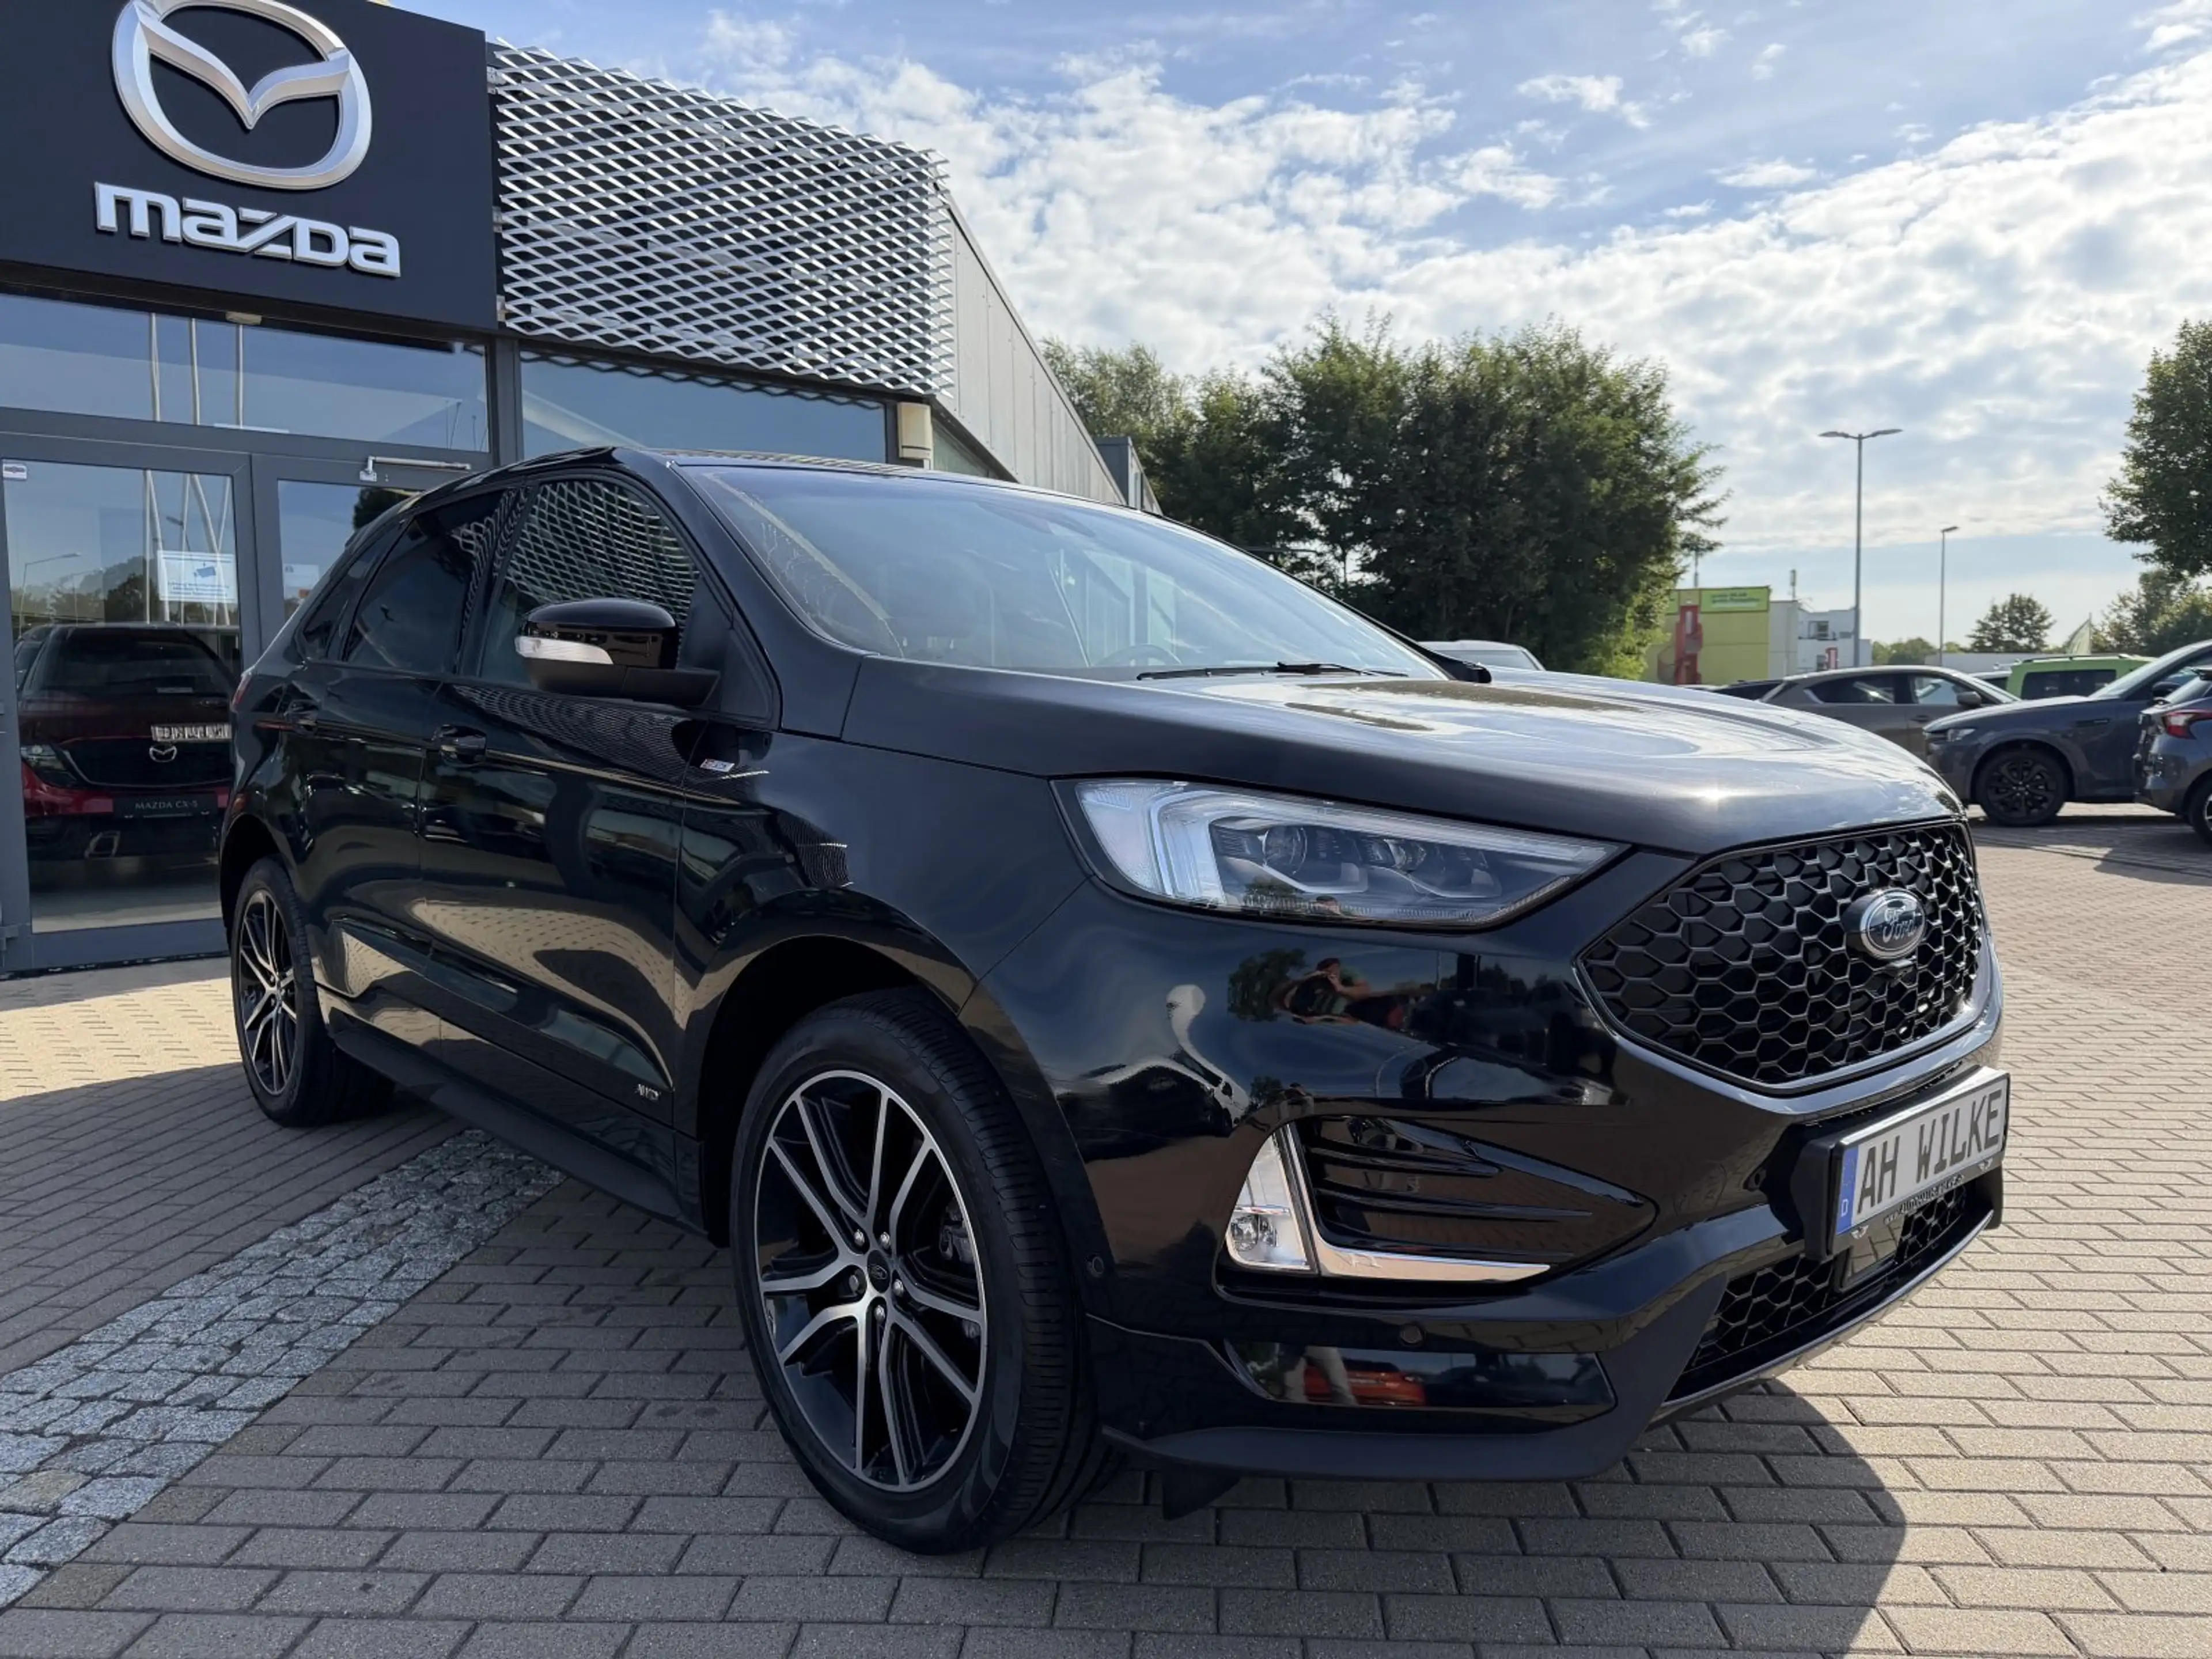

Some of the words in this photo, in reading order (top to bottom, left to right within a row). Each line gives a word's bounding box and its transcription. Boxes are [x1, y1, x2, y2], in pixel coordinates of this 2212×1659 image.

[135, 801, 173, 810] MAZDA
[1883, 906, 1916, 944] Ford
[1857, 1135, 1900, 1214] AH
[1915, 1089, 2002, 1184] WILKE
[1840, 1198, 1849, 1217] D
